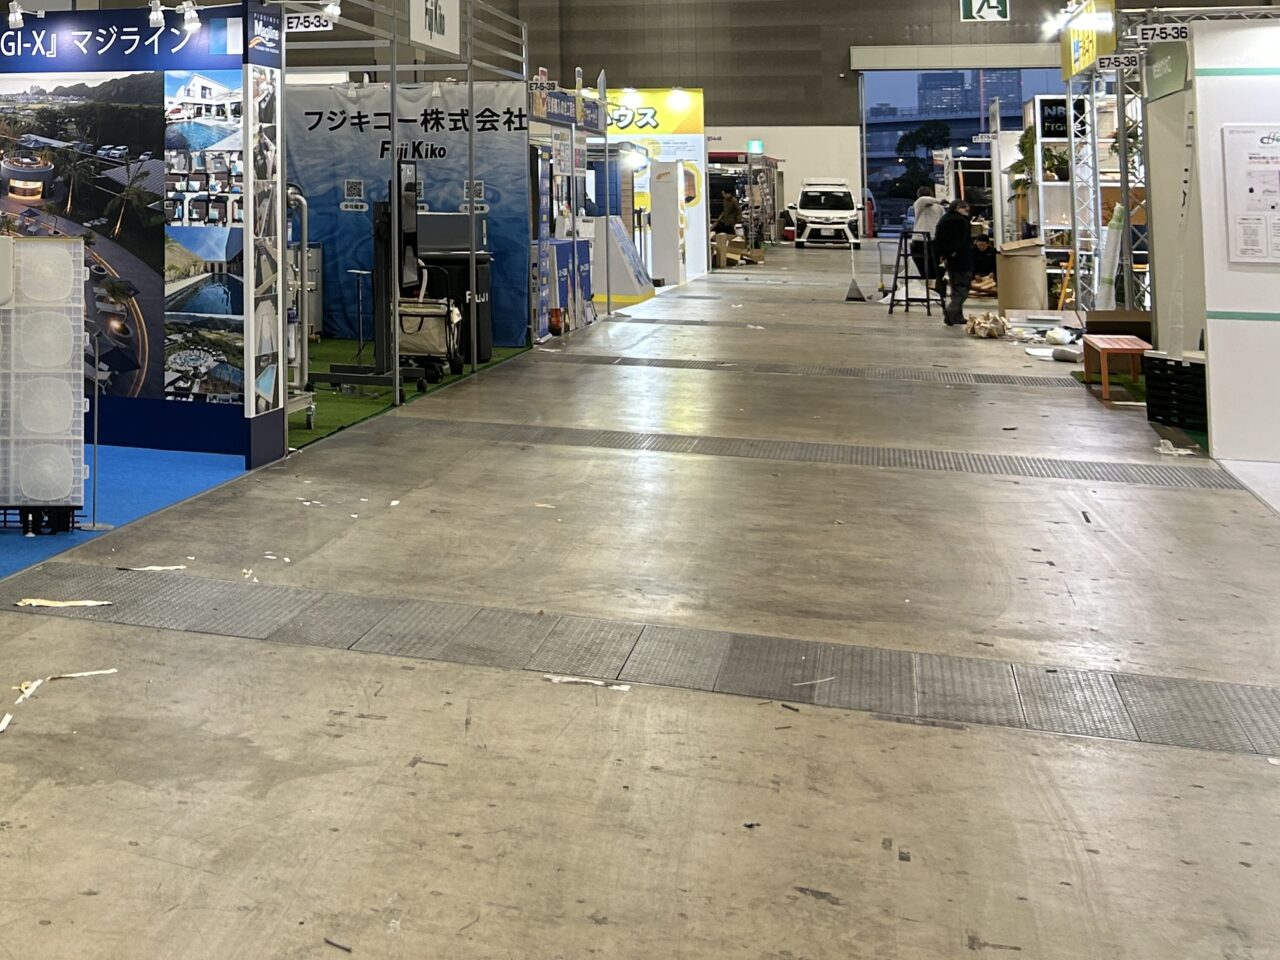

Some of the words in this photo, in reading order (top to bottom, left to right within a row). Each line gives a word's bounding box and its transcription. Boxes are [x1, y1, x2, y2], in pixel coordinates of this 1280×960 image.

[1141, 27, 1188, 41] E7-5-36
[1099, 56, 1138, 69] E7-5-38
[304, 107, 528, 133] フジキコー株式会社
[411, 140, 447, 160] Kiko
[465, 290, 489, 304] FUJI
